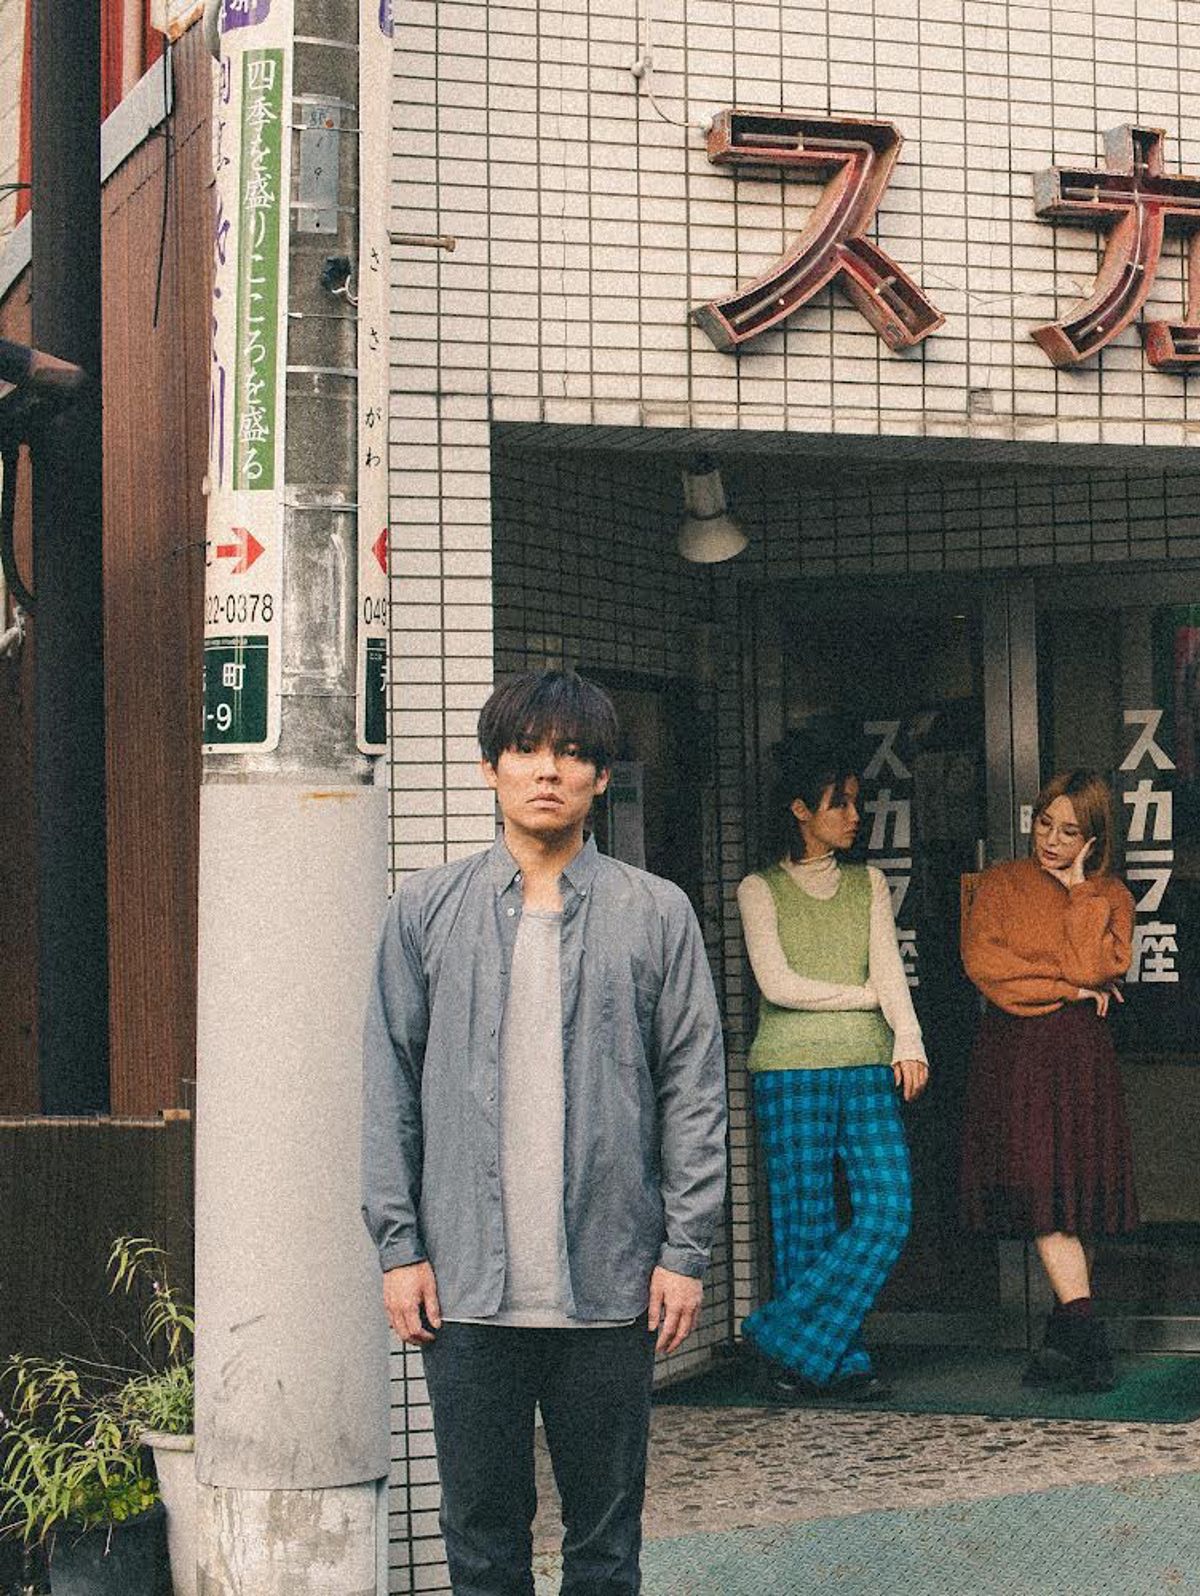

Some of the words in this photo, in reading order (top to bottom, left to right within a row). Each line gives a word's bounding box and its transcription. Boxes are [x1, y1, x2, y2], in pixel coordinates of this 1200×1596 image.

[238, 58, 278, 481] 四季を盛りこころを盛る
[205, 594, 274, 624] 22-0378
[1119, 709, 1179, 983] スカラ座
